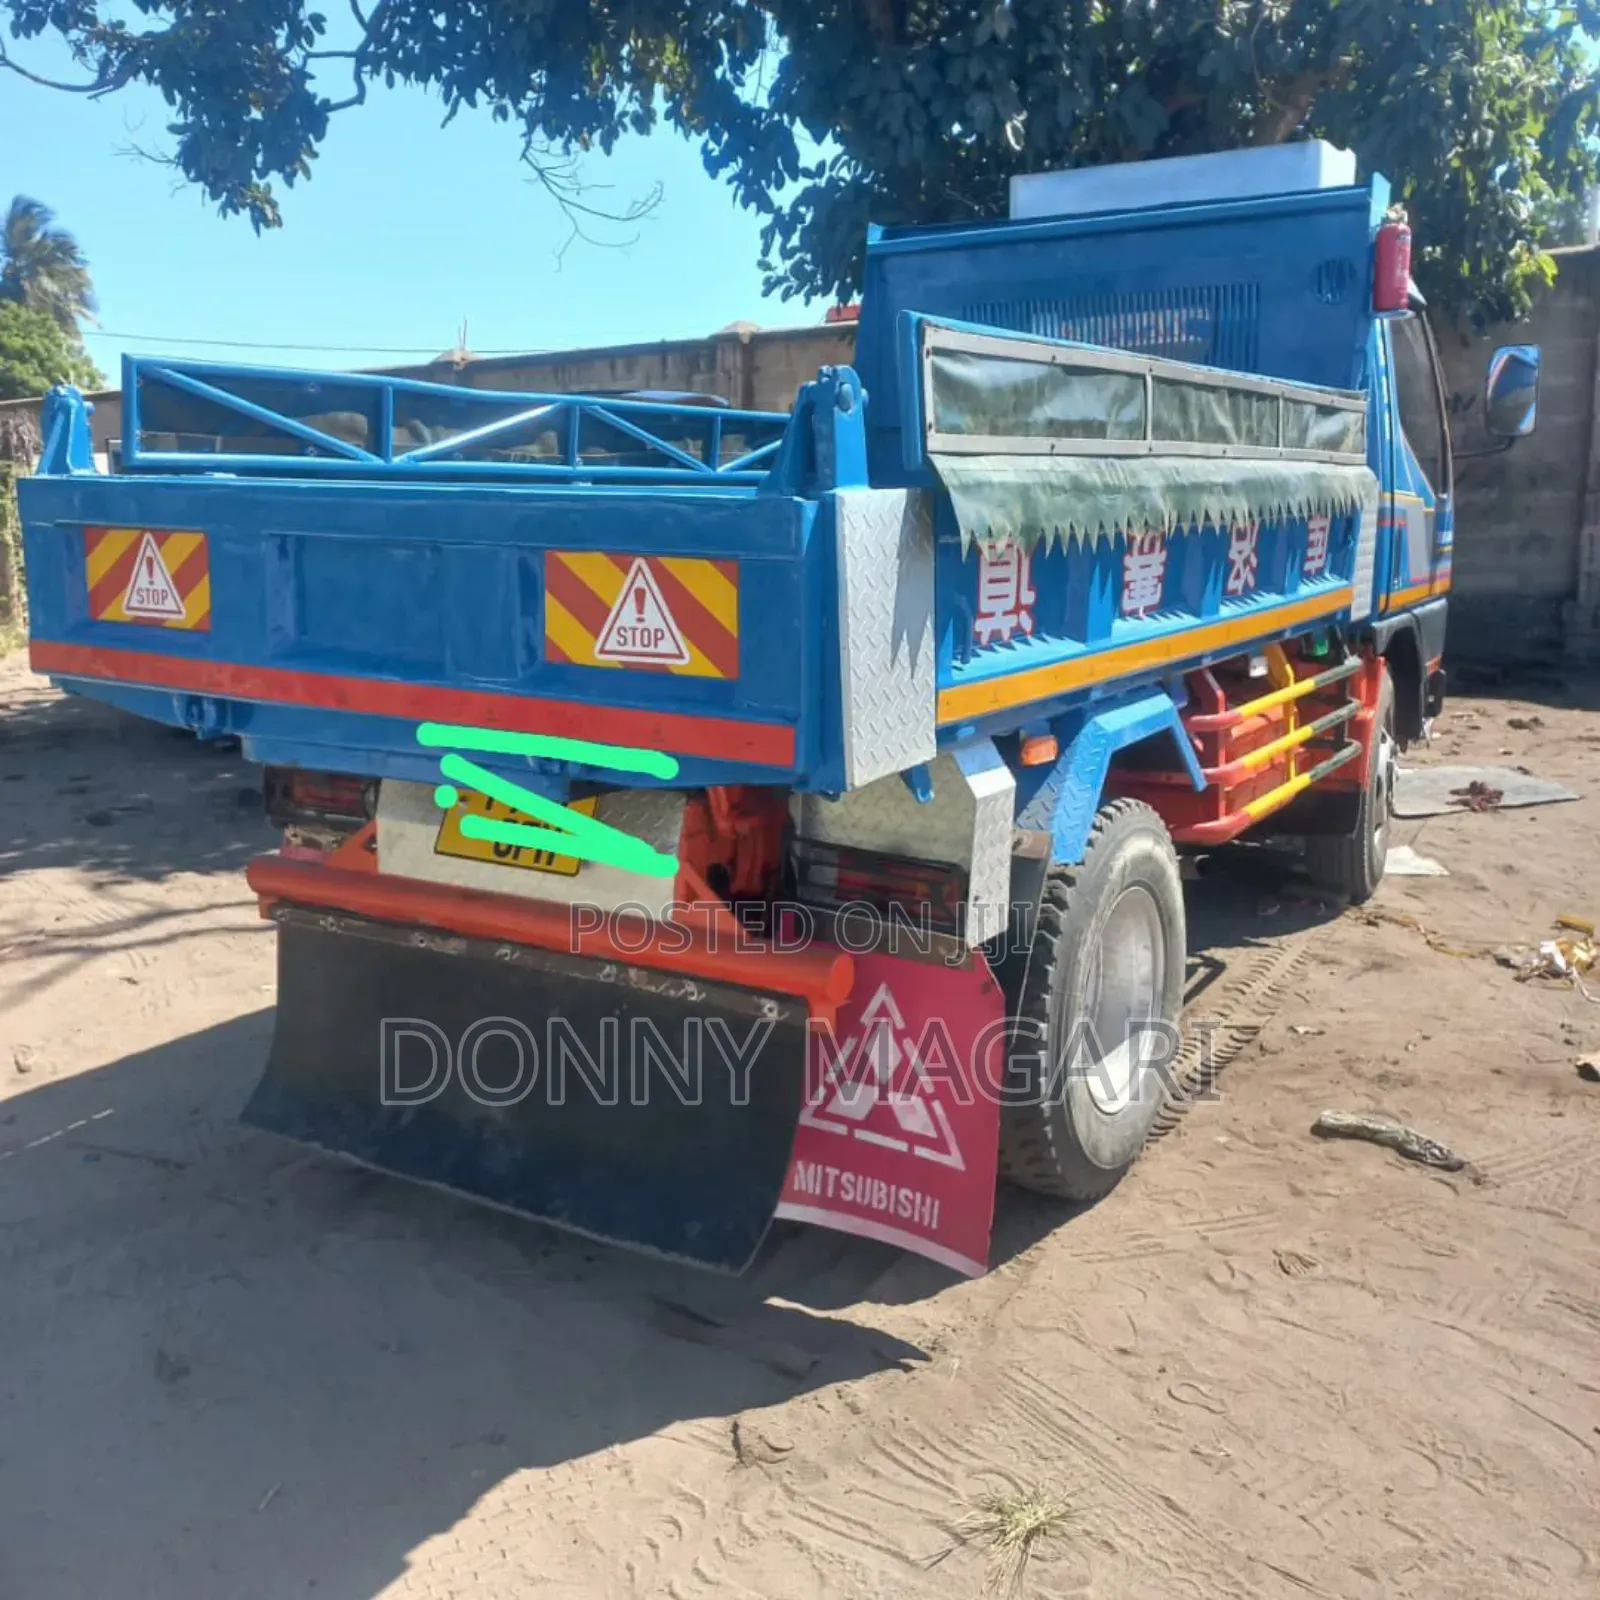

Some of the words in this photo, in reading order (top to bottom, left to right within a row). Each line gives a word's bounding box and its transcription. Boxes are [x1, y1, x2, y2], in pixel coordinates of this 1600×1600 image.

[135, 587, 169, 606] STOP
[616, 626, 666, 649] STOP
[793, 1160, 941, 1229] MITSUBISHI
